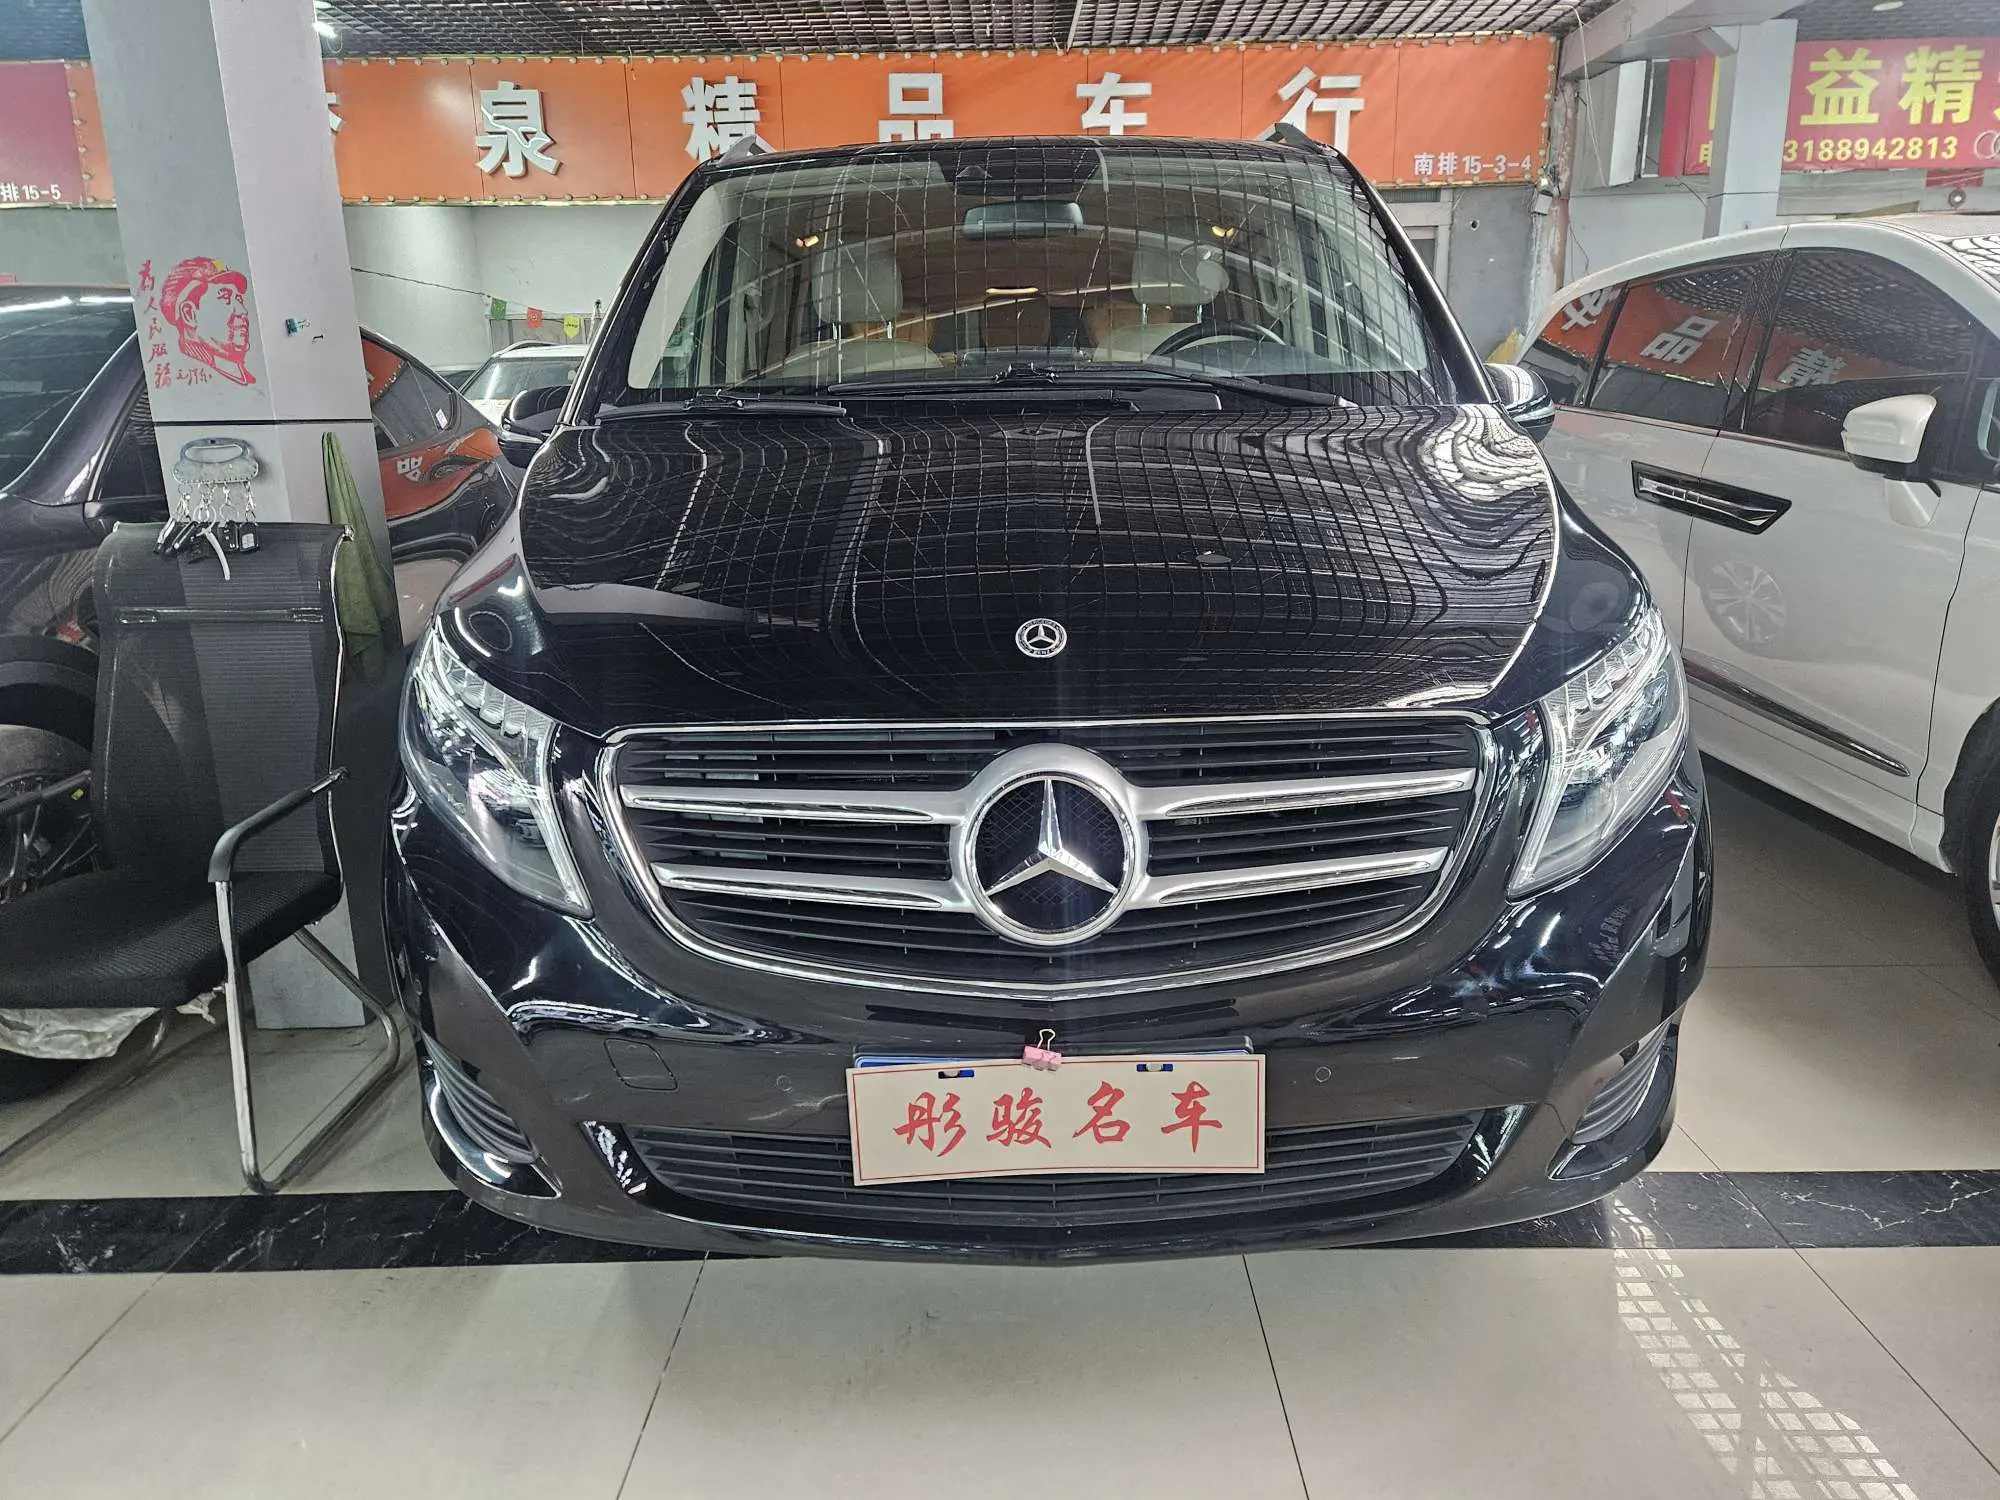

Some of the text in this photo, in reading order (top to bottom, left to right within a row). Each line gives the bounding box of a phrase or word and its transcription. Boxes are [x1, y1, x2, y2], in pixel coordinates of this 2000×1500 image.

[326, 65, 1364, 177] 泉精品车行
[1799, 44, 2000, 125] 益精
[892, 1081, 1224, 1158] 彤骏名车
